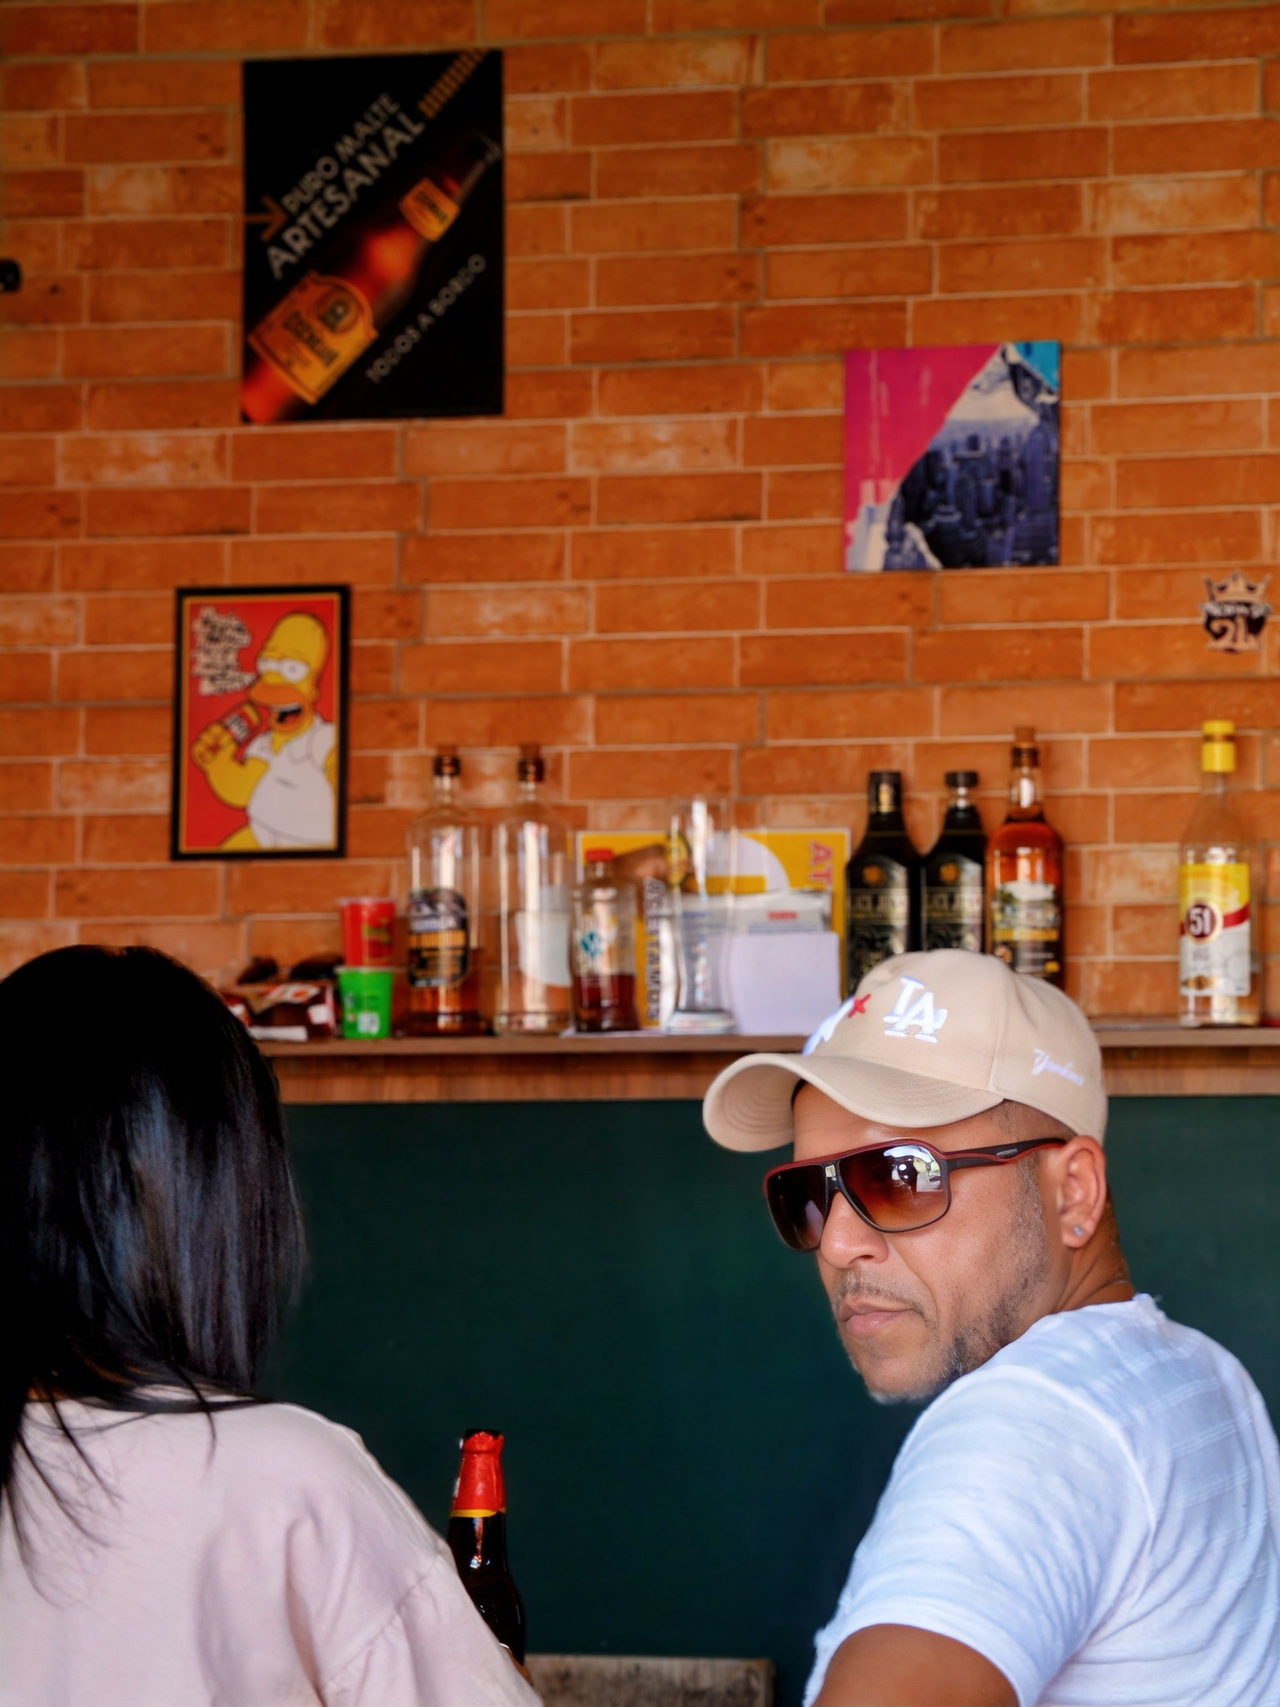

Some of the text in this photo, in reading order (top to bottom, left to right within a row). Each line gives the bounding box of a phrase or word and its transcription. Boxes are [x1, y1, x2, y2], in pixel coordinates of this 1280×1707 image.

[266, 113, 425, 279] ARTESANAL
[281, 91, 402, 216] PURO MALTE
[365, 327, 422, 384] TODOS
[427, 253, 487, 318] BORDO
[1187, 906, 1211, 936] 51
[882, 975, 949, 1044] LA
